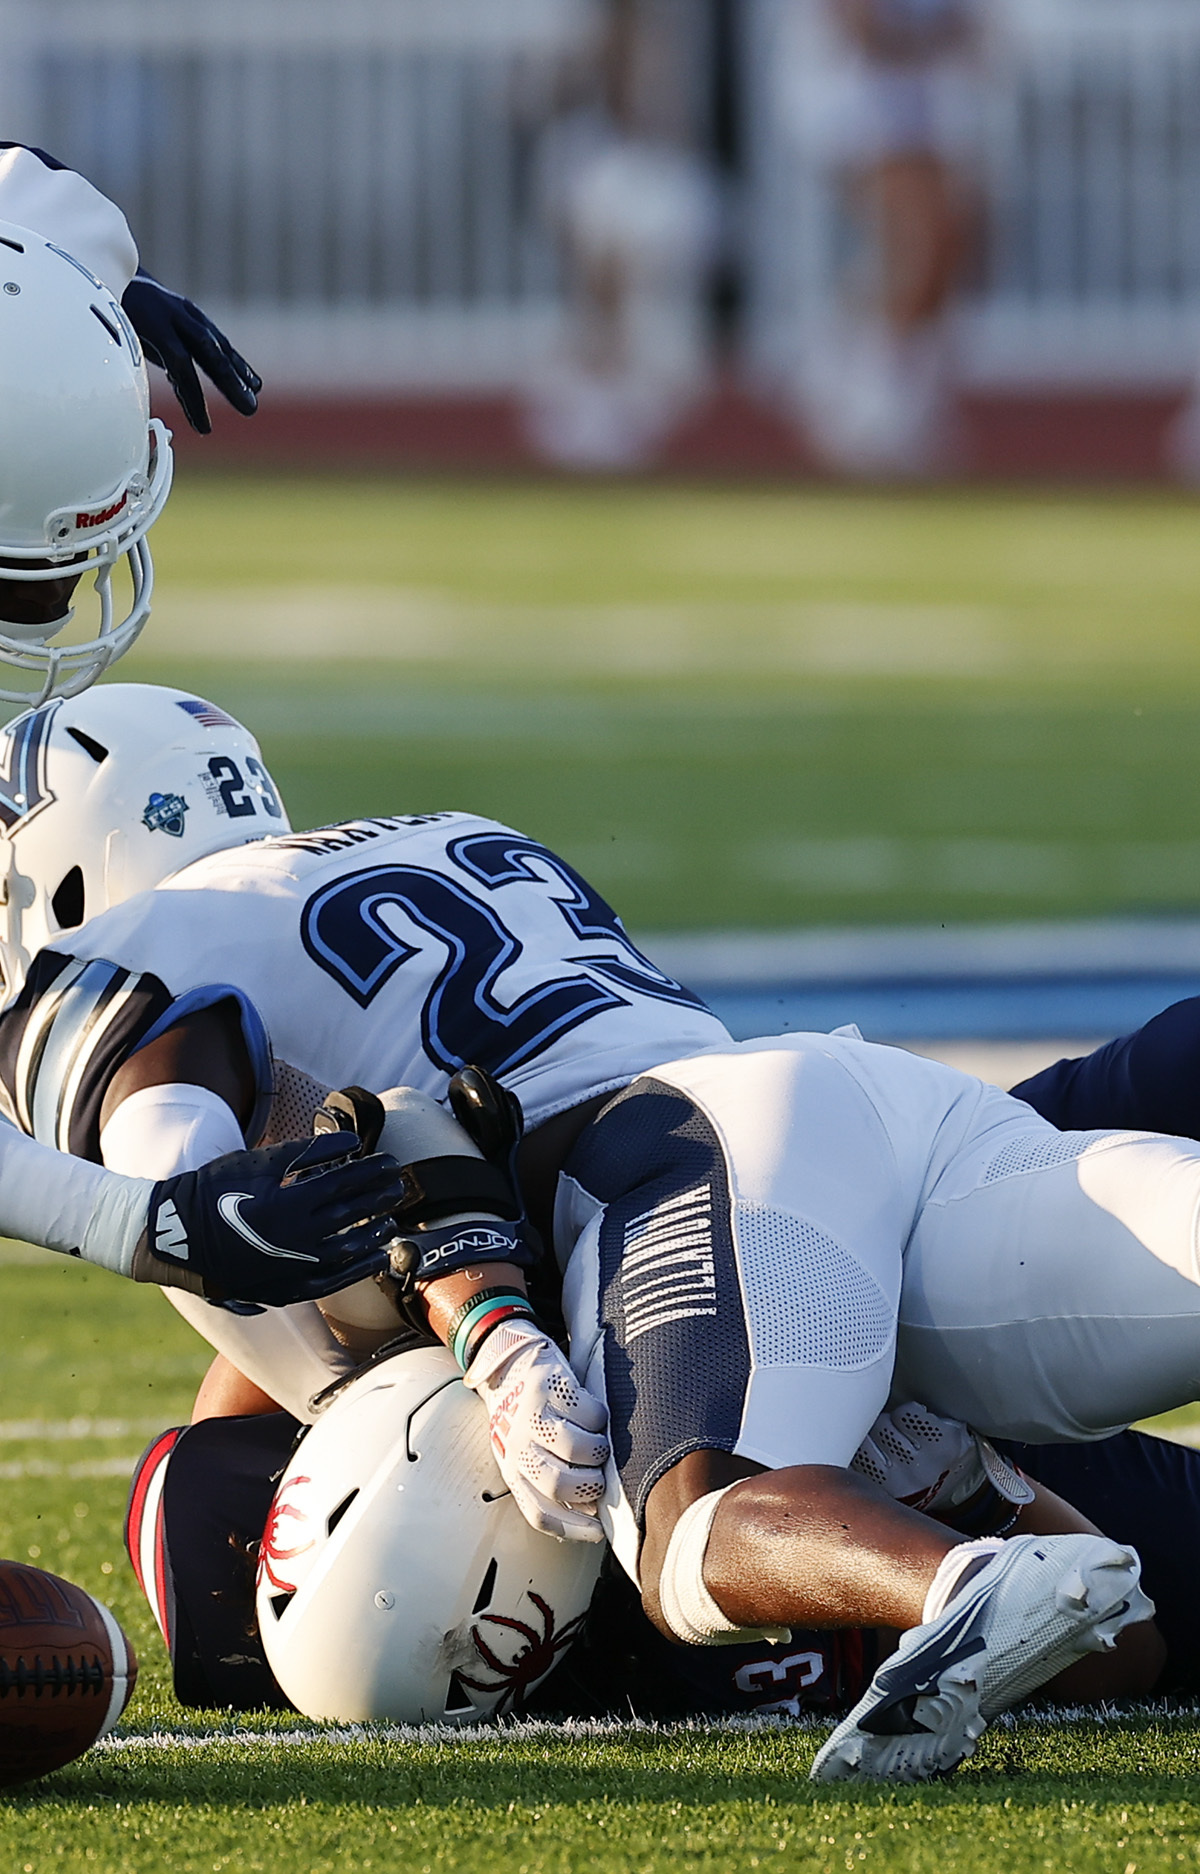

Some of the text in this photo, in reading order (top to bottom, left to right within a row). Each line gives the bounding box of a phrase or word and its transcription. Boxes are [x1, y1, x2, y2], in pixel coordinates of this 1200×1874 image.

[148, 801, 184, 826] FCS
[208, 756, 282, 818] 23
[300, 832, 715, 1076] 23
[422, 1233, 519, 1268] DONJOY
[620, 1183, 717, 1345] VILLANOVA
